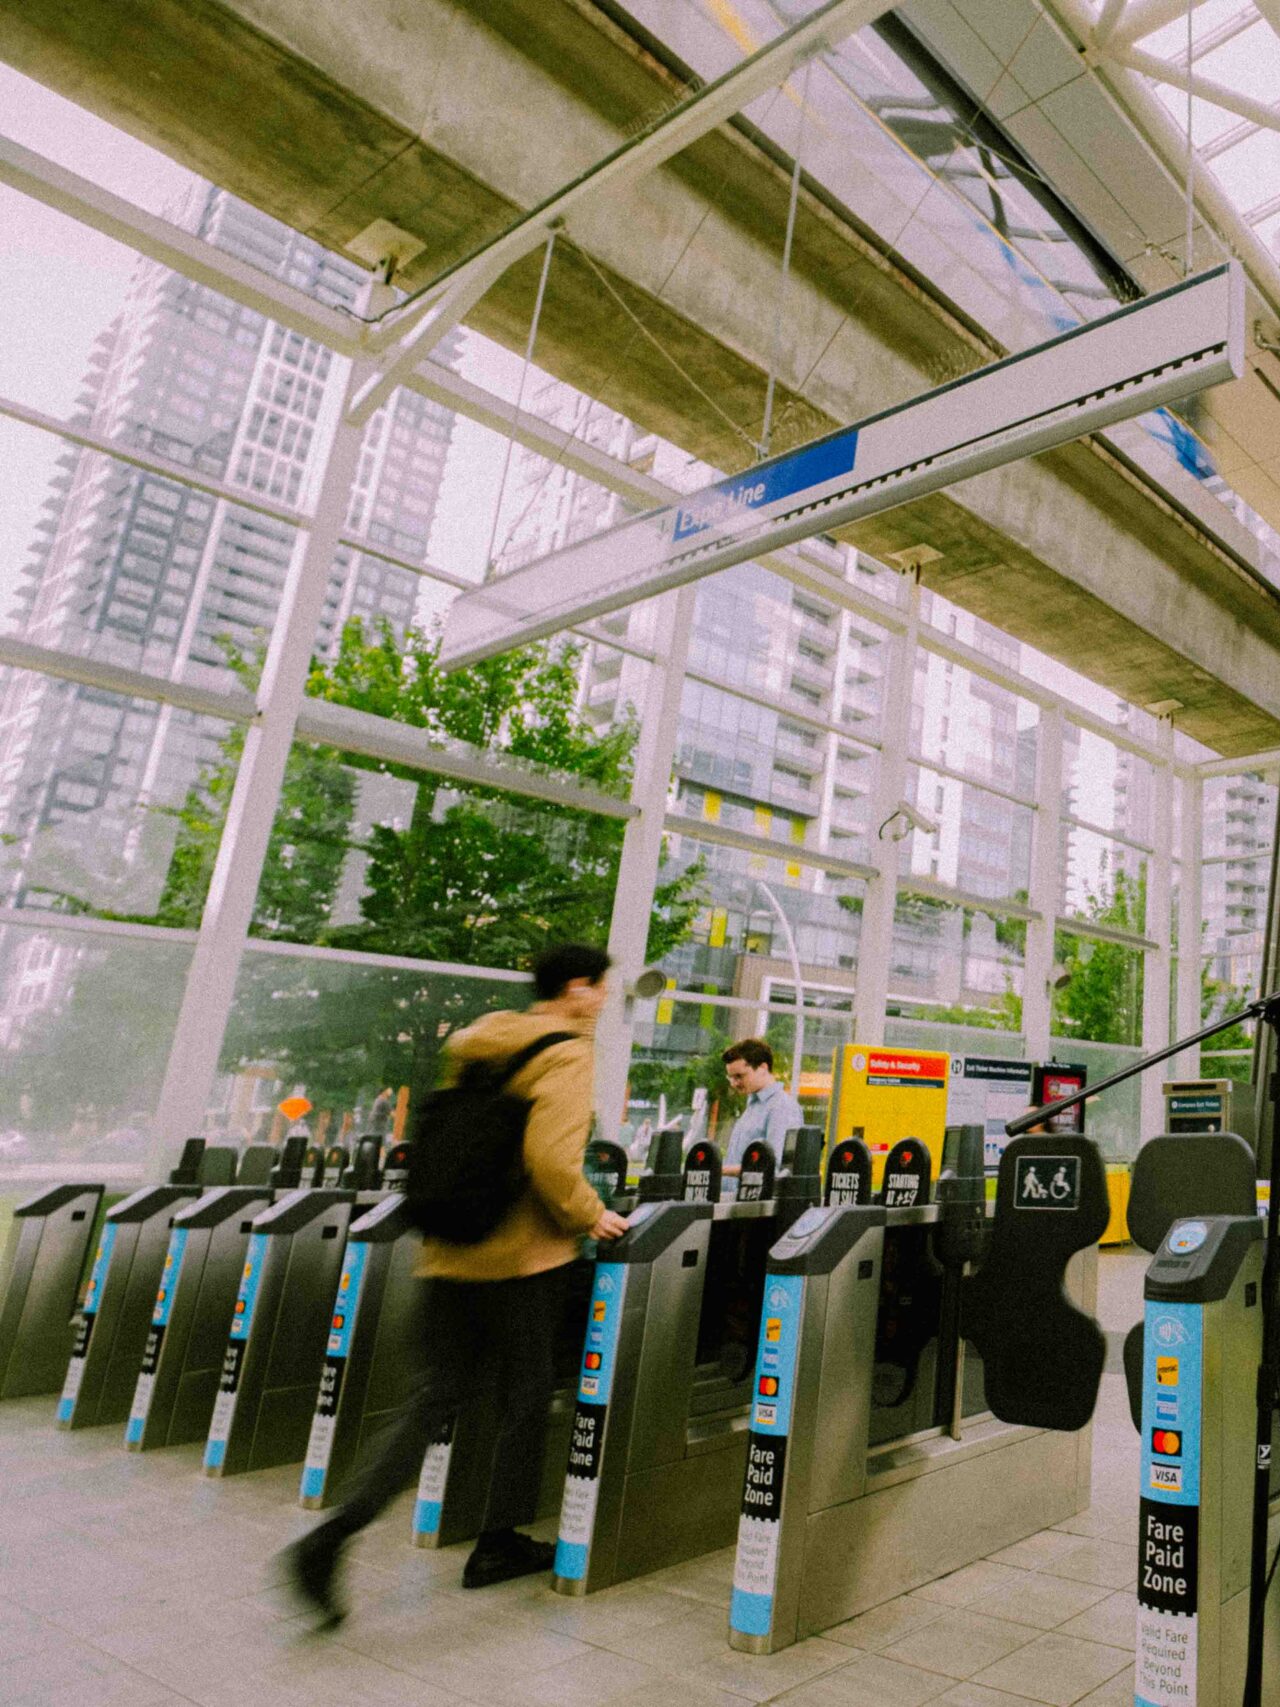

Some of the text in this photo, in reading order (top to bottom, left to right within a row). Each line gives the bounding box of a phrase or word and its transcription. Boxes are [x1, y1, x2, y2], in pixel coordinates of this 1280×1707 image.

[687, 1170, 710, 1185] TICKETS
[832, 1172, 860, 1189] TICKETS
[888, 1174, 920, 1190] STARTING
[842, 1190, 858, 1206] SALE
[750, 1444, 775, 1465] Fare
[747, 1464, 773, 1485] Paid
[1155, 1469, 1177, 1483] VISA
[744, 1484, 774, 1506] Zone
[1147, 1515, 1184, 1542] Fare
[1145, 1540, 1184, 1568] Paid
[1142, 1565, 1187, 1595] Zone
[1165, 1628, 1188, 1645] Fare
[1141, 1637, 1185, 1661] Required
[1143, 1659, 1181, 1679] Beyond
[1159, 1677, 1189, 1696] Point
